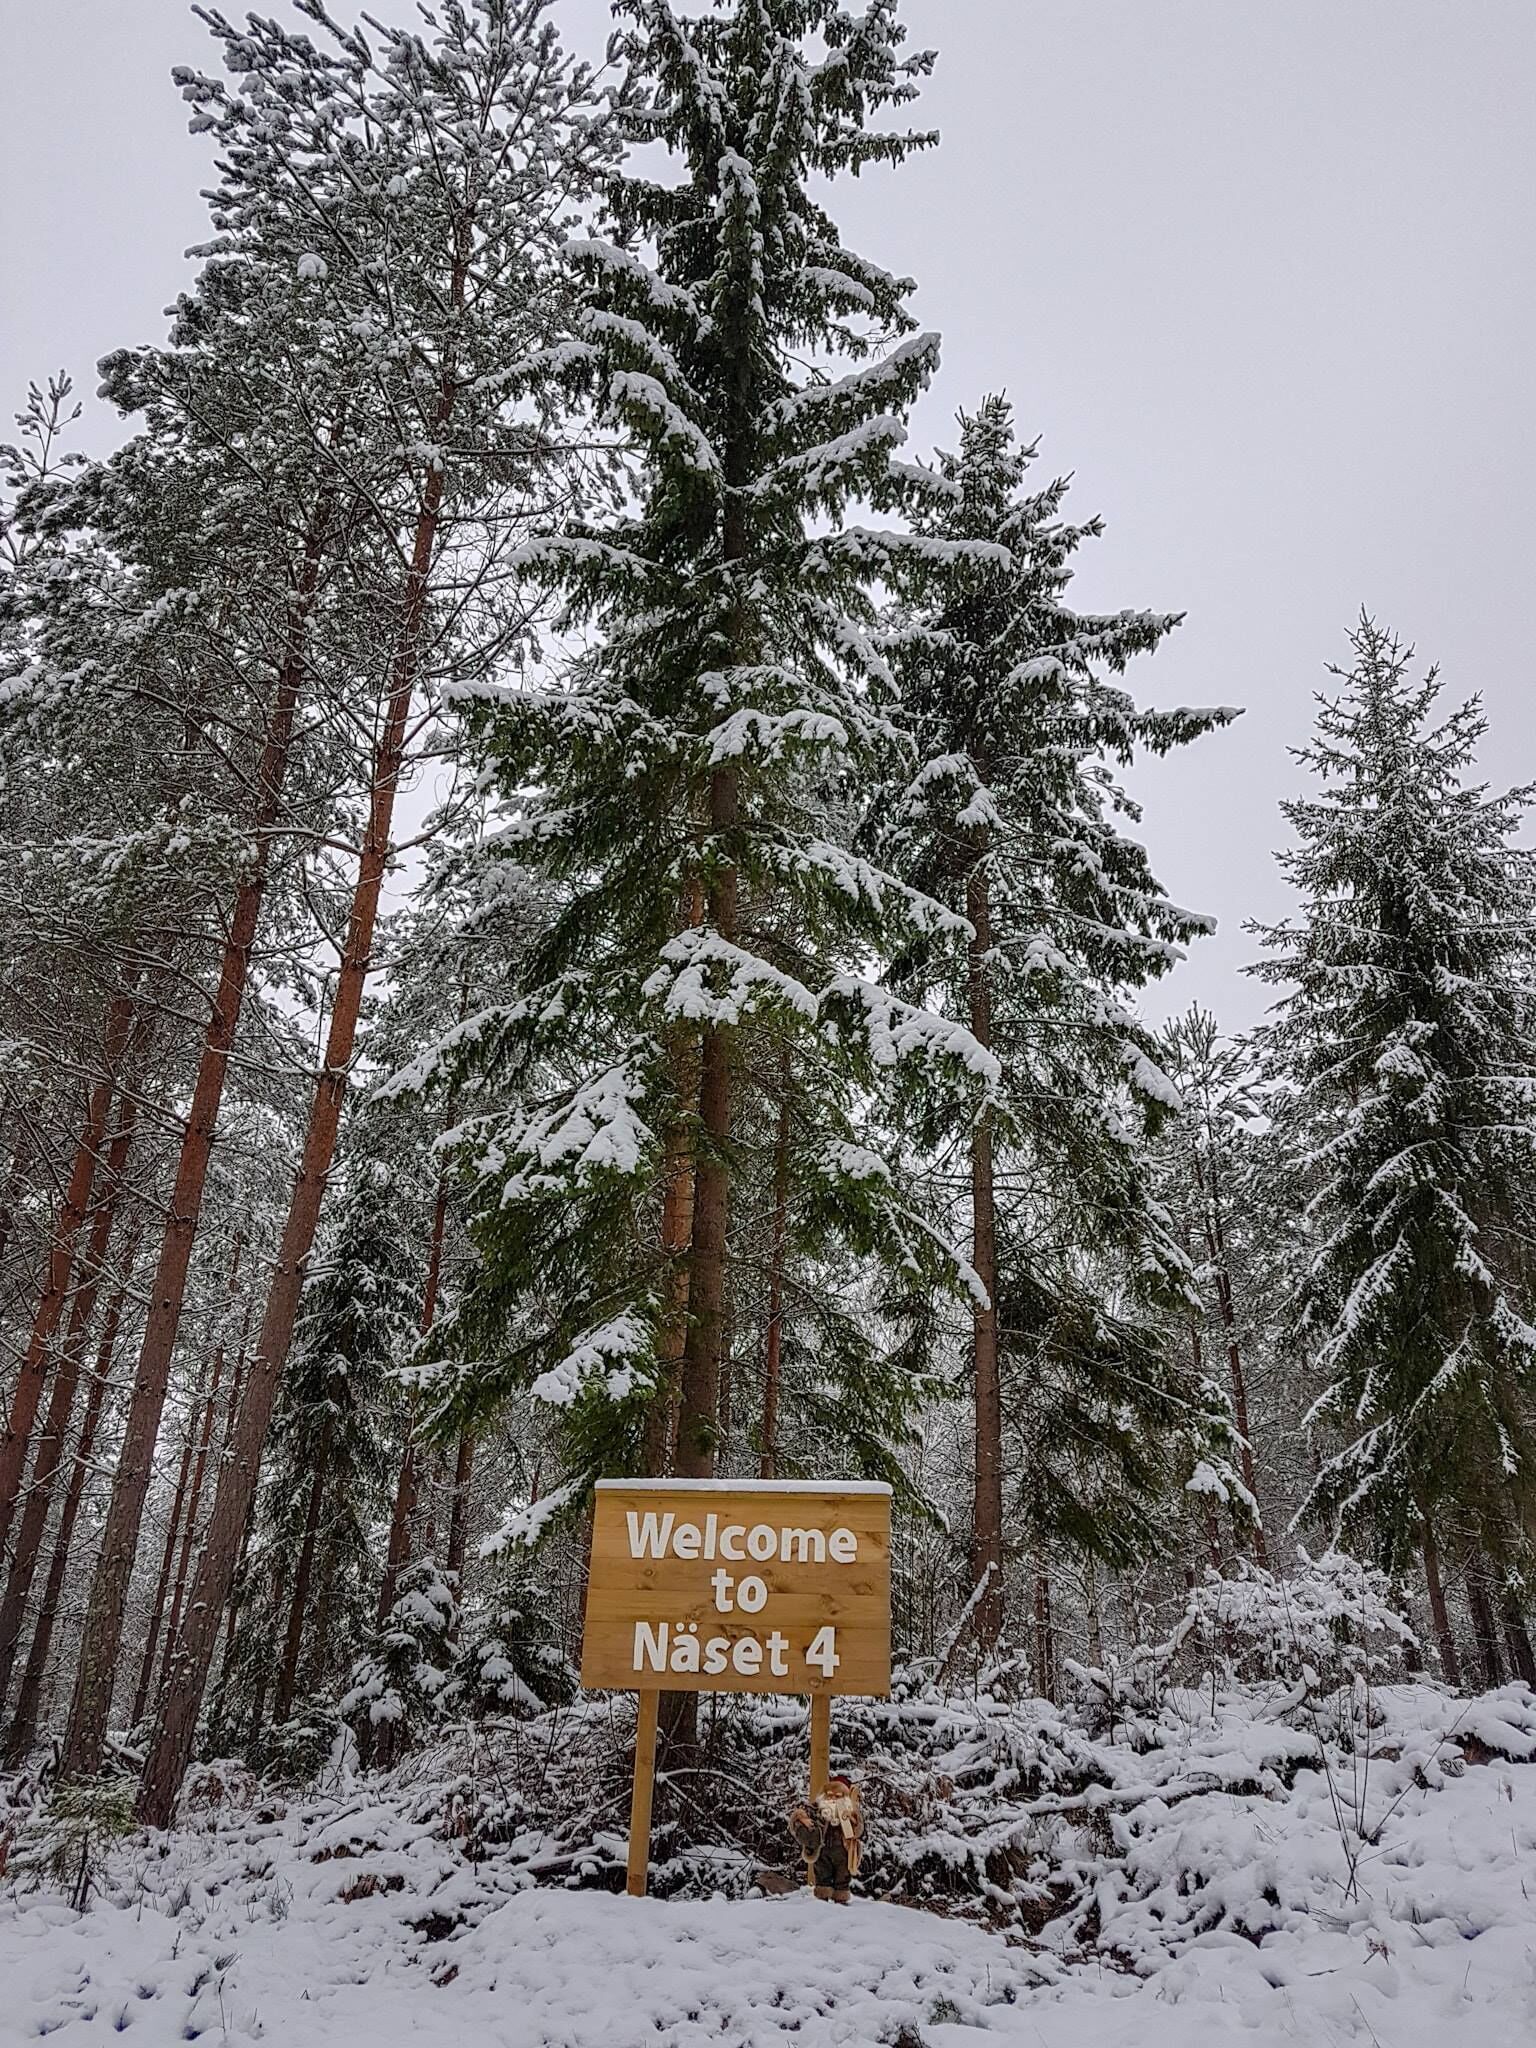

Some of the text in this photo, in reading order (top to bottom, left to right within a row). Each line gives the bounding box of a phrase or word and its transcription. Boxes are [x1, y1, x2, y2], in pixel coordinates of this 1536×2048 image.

[625, 1511, 858, 1564] Welcome
[711, 1568, 768, 1613] to
[633, 1621, 840, 1678] Näset 4
